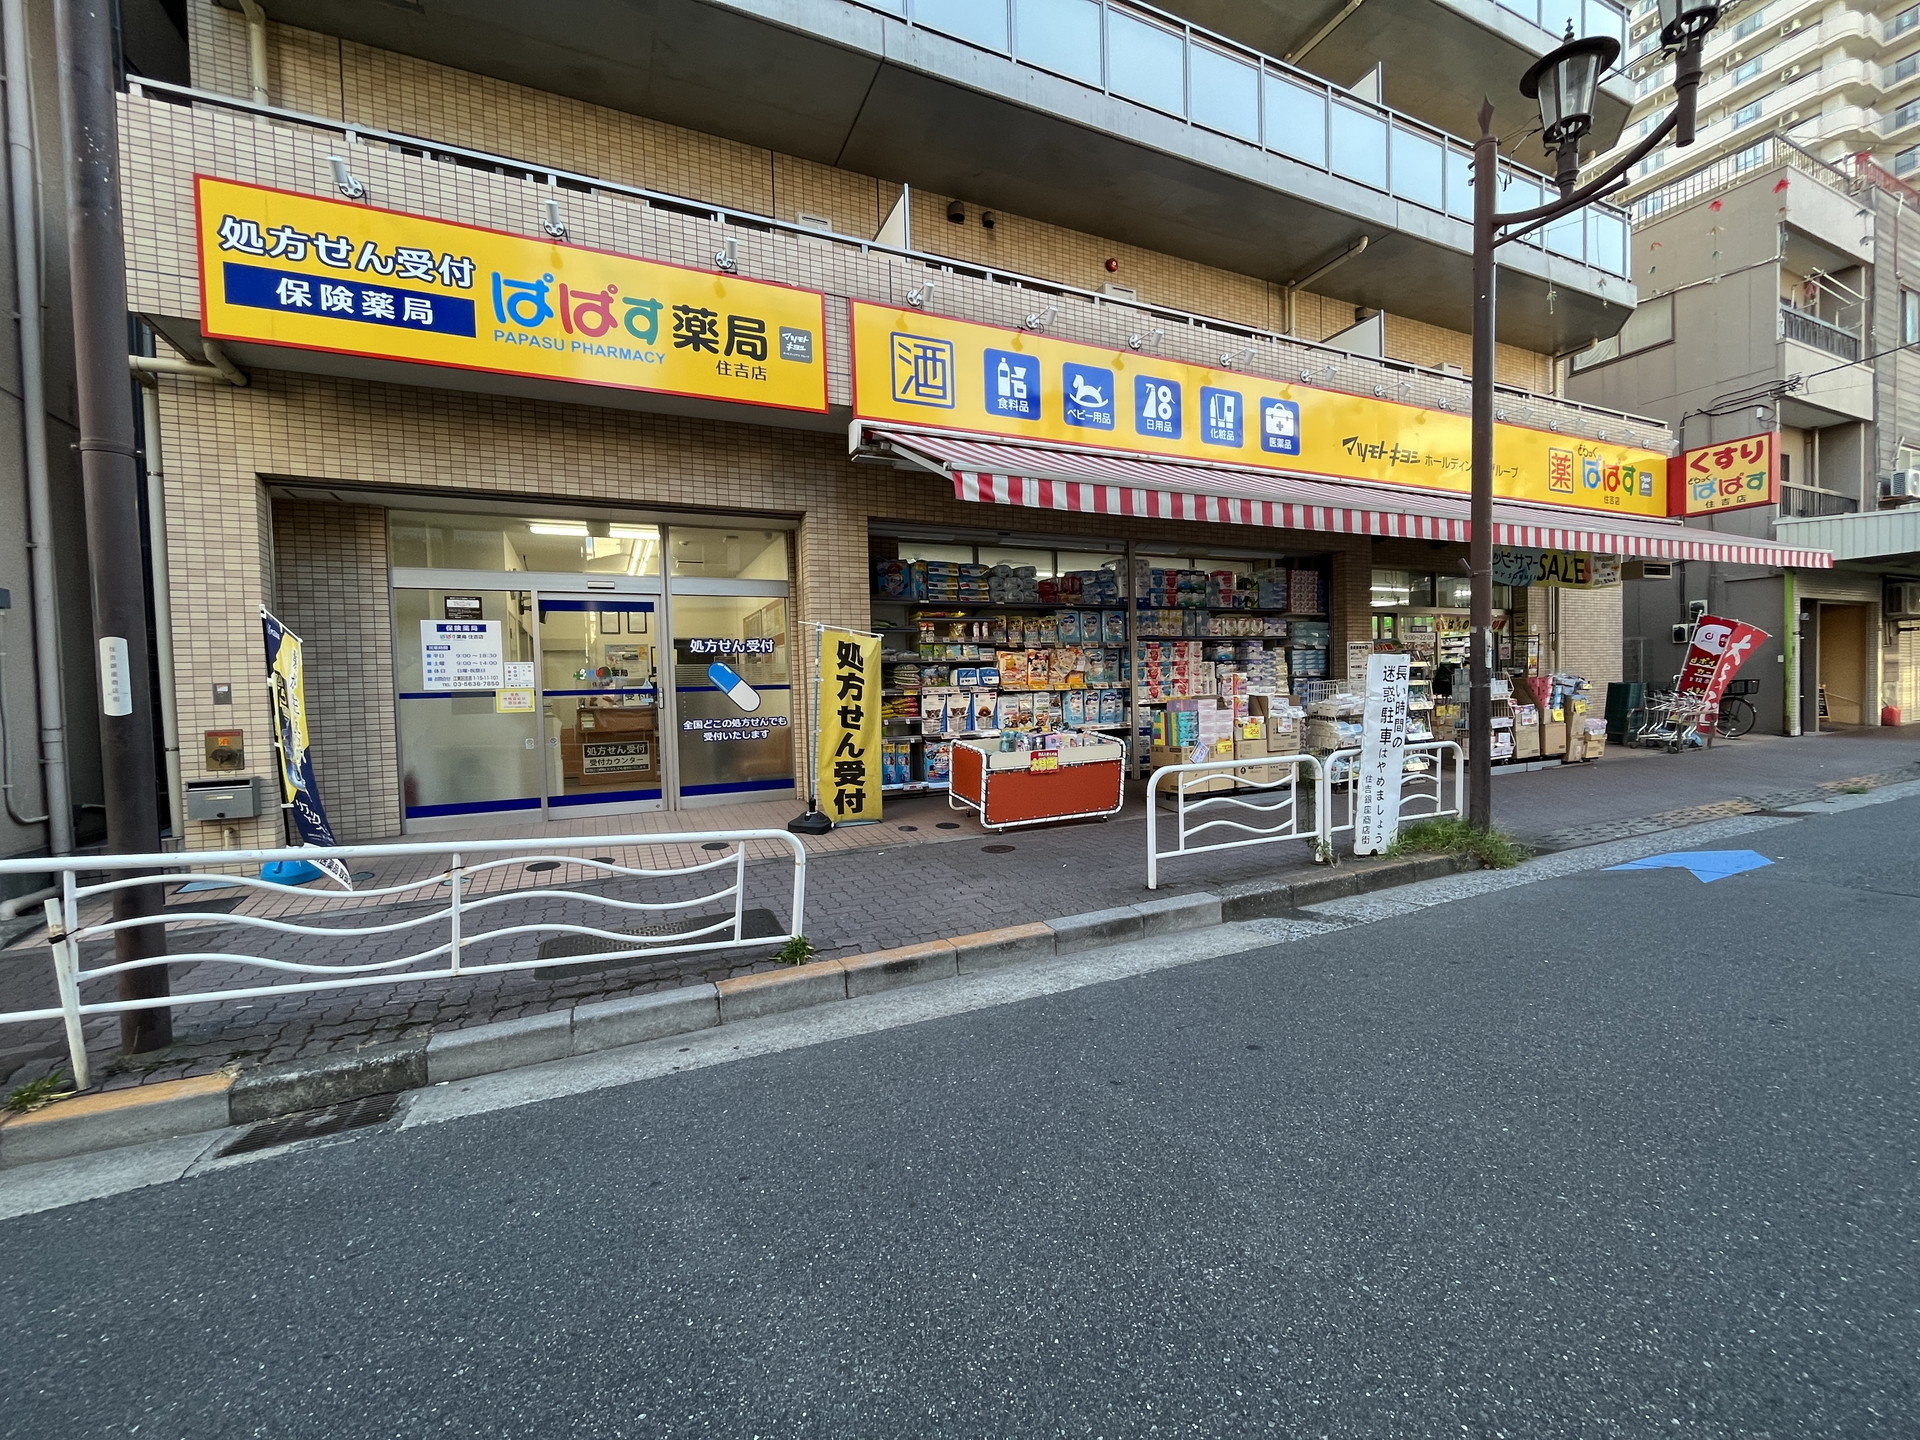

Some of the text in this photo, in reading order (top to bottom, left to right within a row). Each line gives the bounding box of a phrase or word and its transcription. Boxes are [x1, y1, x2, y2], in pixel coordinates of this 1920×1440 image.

[217, 215, 476, 290] 処方せん受付
[276, 276, 435, 325] 保険薬局
[494, 328, 667, 366] PAPASU PHARMACY
[714, 357, 769, 383] 住吉店
[898, 341, 948, 398] 酒
[997, 398, 1030, 415] 食料品
[1066, 407, 1113, 426] ベビー用品
[1145, 418, 1174, 434] 日用品
[1209, 428, 1236, 443] 化粧品
[1268, 436, 1293, 451] 医薬品
[1342, 435, 1519, 479] マツモトキヨシ ホールディンループ
[1689, 439, 1764, 474] くすり
[1551, 452, 1571, 490] 薬
[1582, 454, 1637, 497] ぱぱす
[1692, 471, 1767, 501] ぱぱす
[1603, 495, 1620, 506] 住吉店
[1705, 494, 1747, 509] 住吉店
[1537, 553, 1587, 585] SALE
[445, 624, 479, 632] 保険薬局
[689, 638, 775, 654] 処方せん受付
[1392, 665, 1408, 748] 長い時間の
[683, 716, 788, 731] 全国どこの処方せんでも
[703, 729, 770, 742] 受付いたします
[833, 640, 867, 816] 処方せん受付
[586, 744, 645, 757] 処方せん受付
[589, 757, 644, 767] 受付カウンター
[1374, 665, 1396, 845] 迷惑駐車はやめましょう
[1361, 774, 1373, 845] 住吉銀座商店街
